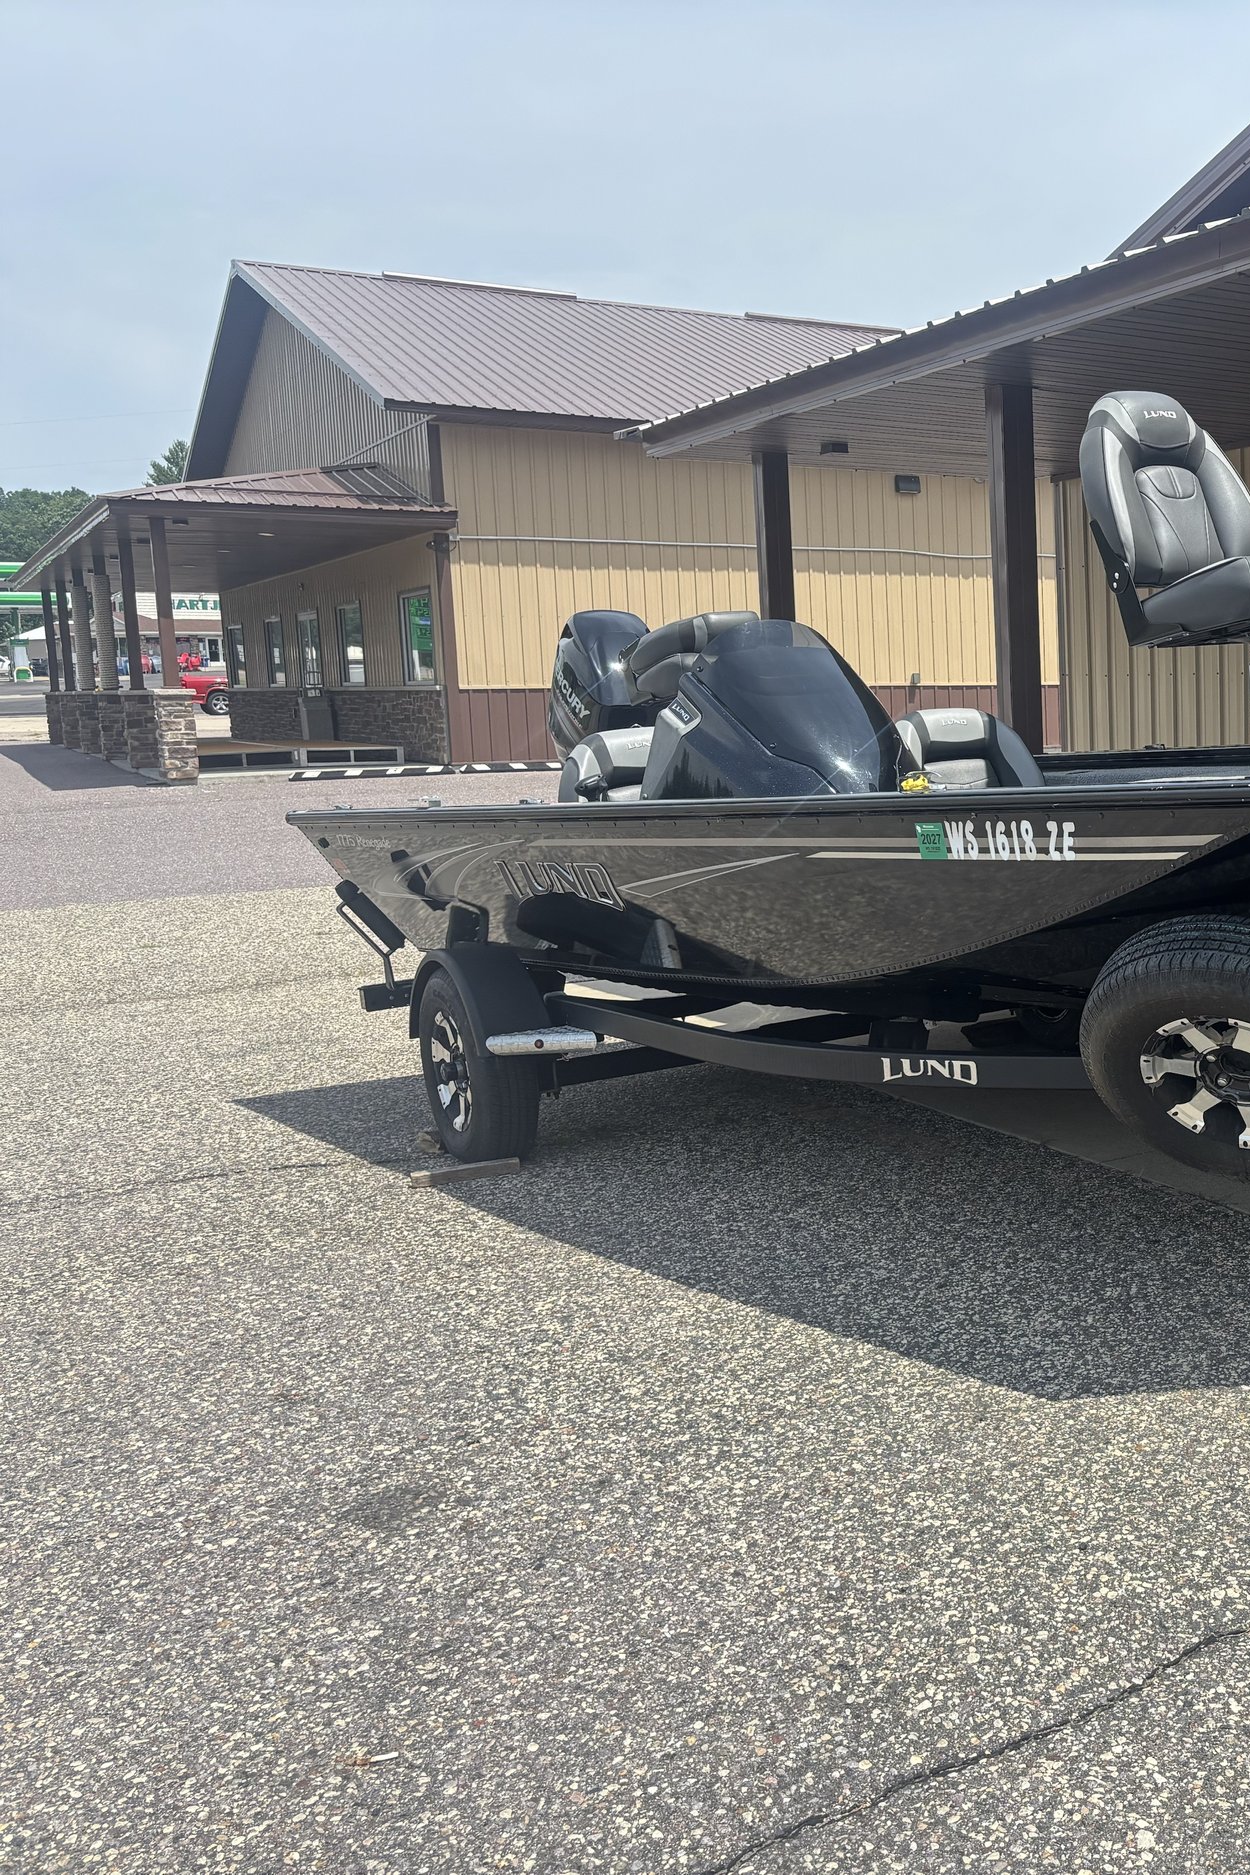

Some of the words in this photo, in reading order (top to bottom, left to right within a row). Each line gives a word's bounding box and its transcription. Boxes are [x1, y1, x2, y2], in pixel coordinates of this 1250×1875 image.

[1143, 410, 1177, 419] LUND
[171, 598, 221, 610] ARTJ
[671, 703, 690, 721] LUND
[627, 742, 652, 750] LUN
[355, 834, 391, 851] Renegade
[920, 833, 941, 845] 2027
[944, 820, 979, 860] WS
[985, 820, 1037, 861] 1618
[494, 860, 626, 912] LUND
[881, 1057, 978, 1086] LUND
